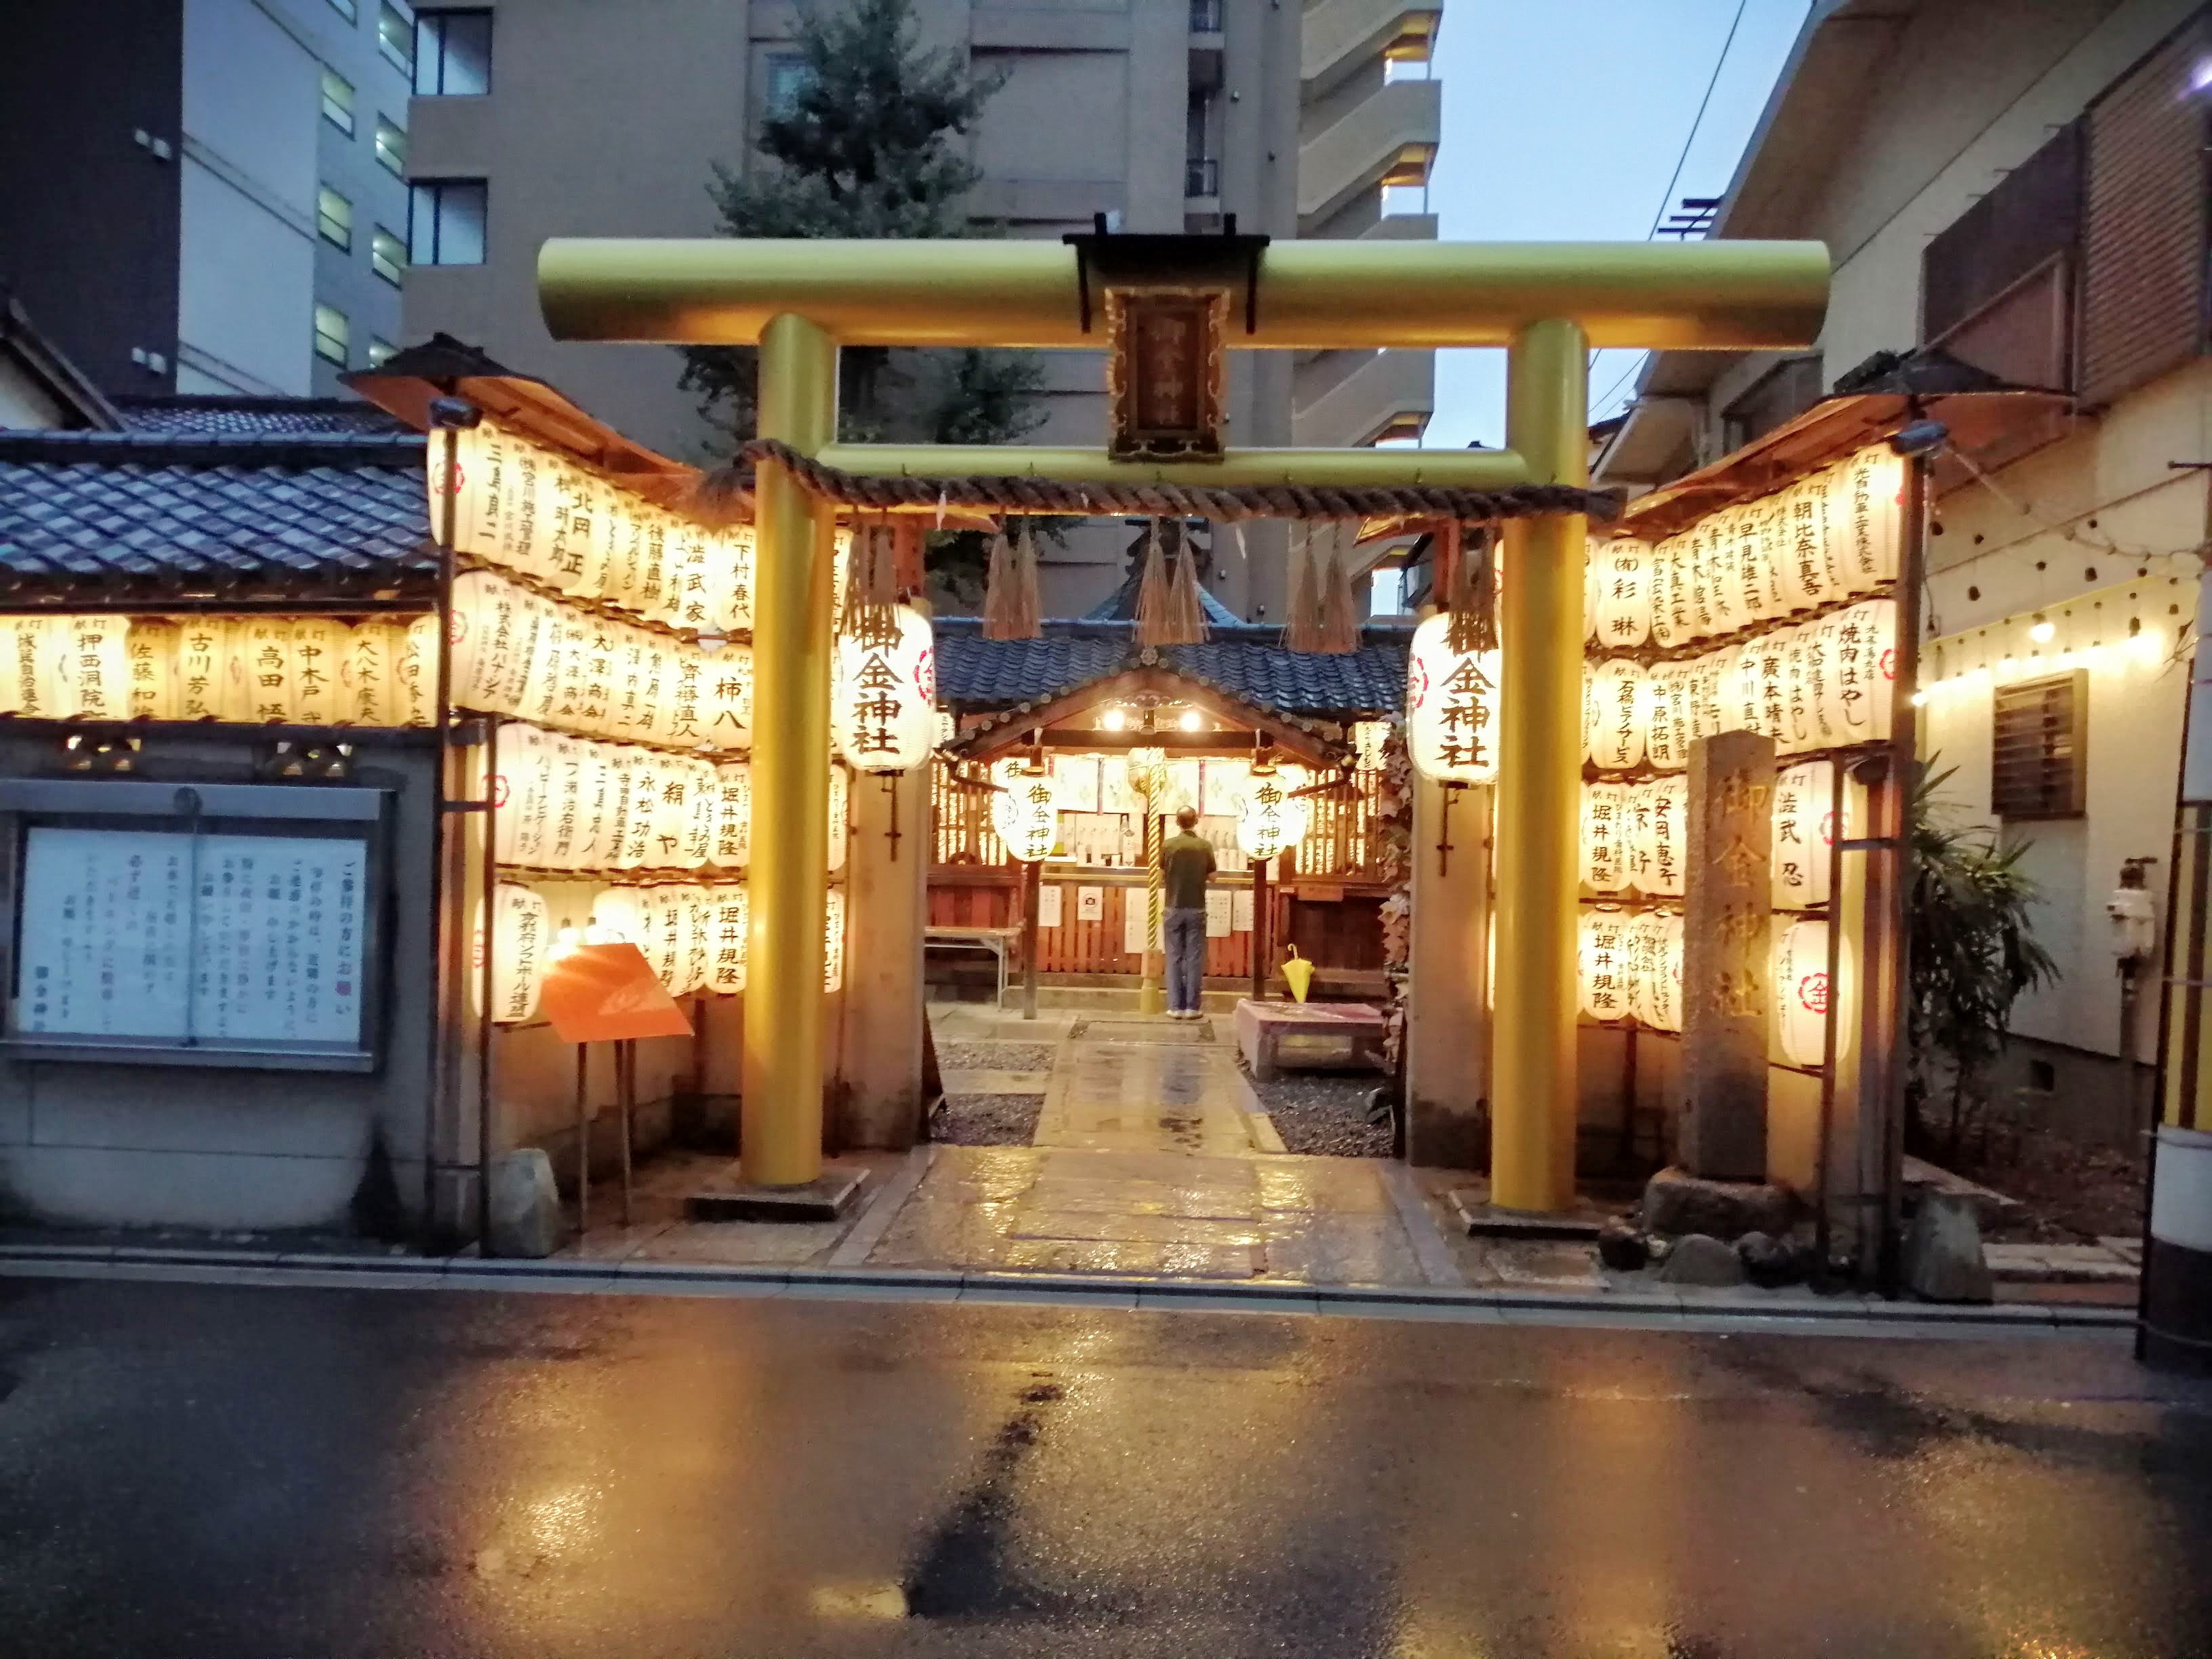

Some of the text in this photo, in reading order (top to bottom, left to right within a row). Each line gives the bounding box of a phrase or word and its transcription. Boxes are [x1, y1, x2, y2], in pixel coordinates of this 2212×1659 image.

[729, 544, 751, 619] 下村春代
[1793, 501, 1823, 596] 朝比奈真吾
[77, 634, 106, 716] 押西洞院
[185, 633, 213, 715] 古川芳弘
[713, 676, 748, 730] 柿八
[1837, 623, 1867, 727] 焼肉はやし
[1611, 679, 1635, 764] 石橋ピアノサービス
[627, 770, 657, 858] 永松功浩
[656, 781, 687, 856] 絹や
[718, 785, 740, 856] 堀井規隆
[1024, 784, 1052, 859] 御金神社
[1254, 781, 1283, 857] 御金神社
[1591, 803, 1613, 882] 堀井規隆
[716, 906, 743, 984] 堀井規隆
[1591, 934, 1619, 1009] 堀井規隆
